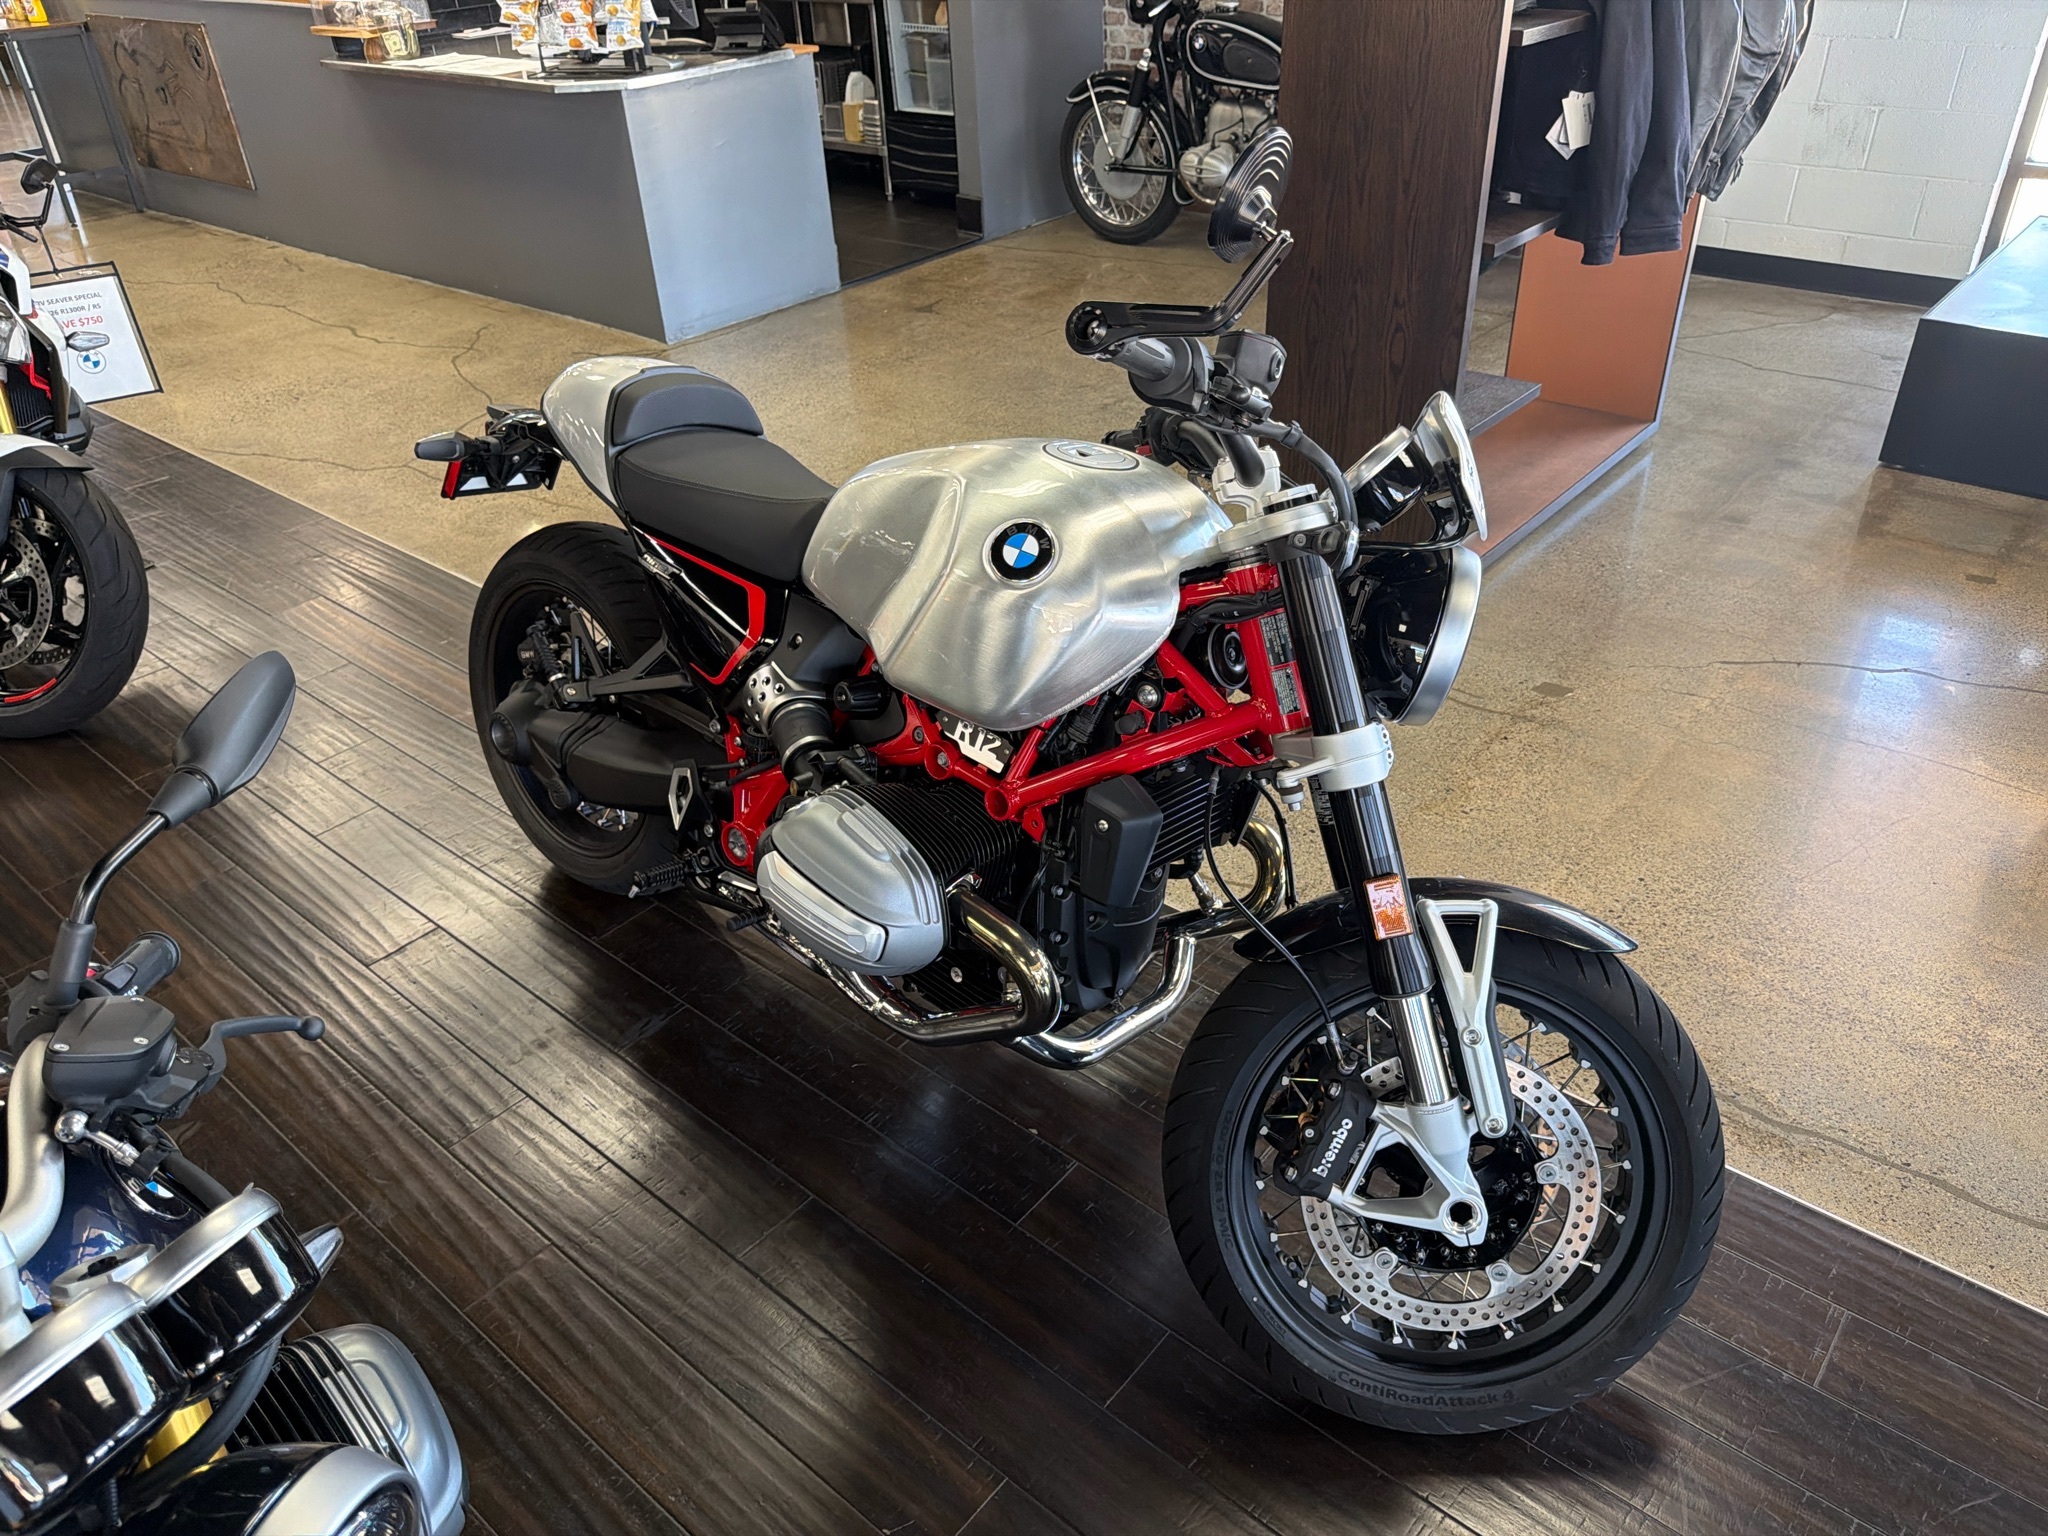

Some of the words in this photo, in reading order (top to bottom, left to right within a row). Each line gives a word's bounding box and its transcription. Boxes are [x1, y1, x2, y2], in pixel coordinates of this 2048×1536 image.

[47, 295, 73, 305] SEAVER
[74, 291, 102, 301] SPECIAL
[60, 305, 86, 314] R1300R
[78, 315, 104, 327] $750
[1006, 524, 1051, 549] BMW
[1312, 1118, 1353, 1178] brembo
[1337, 1370, 1498, 1408] ContiRoadAttack
